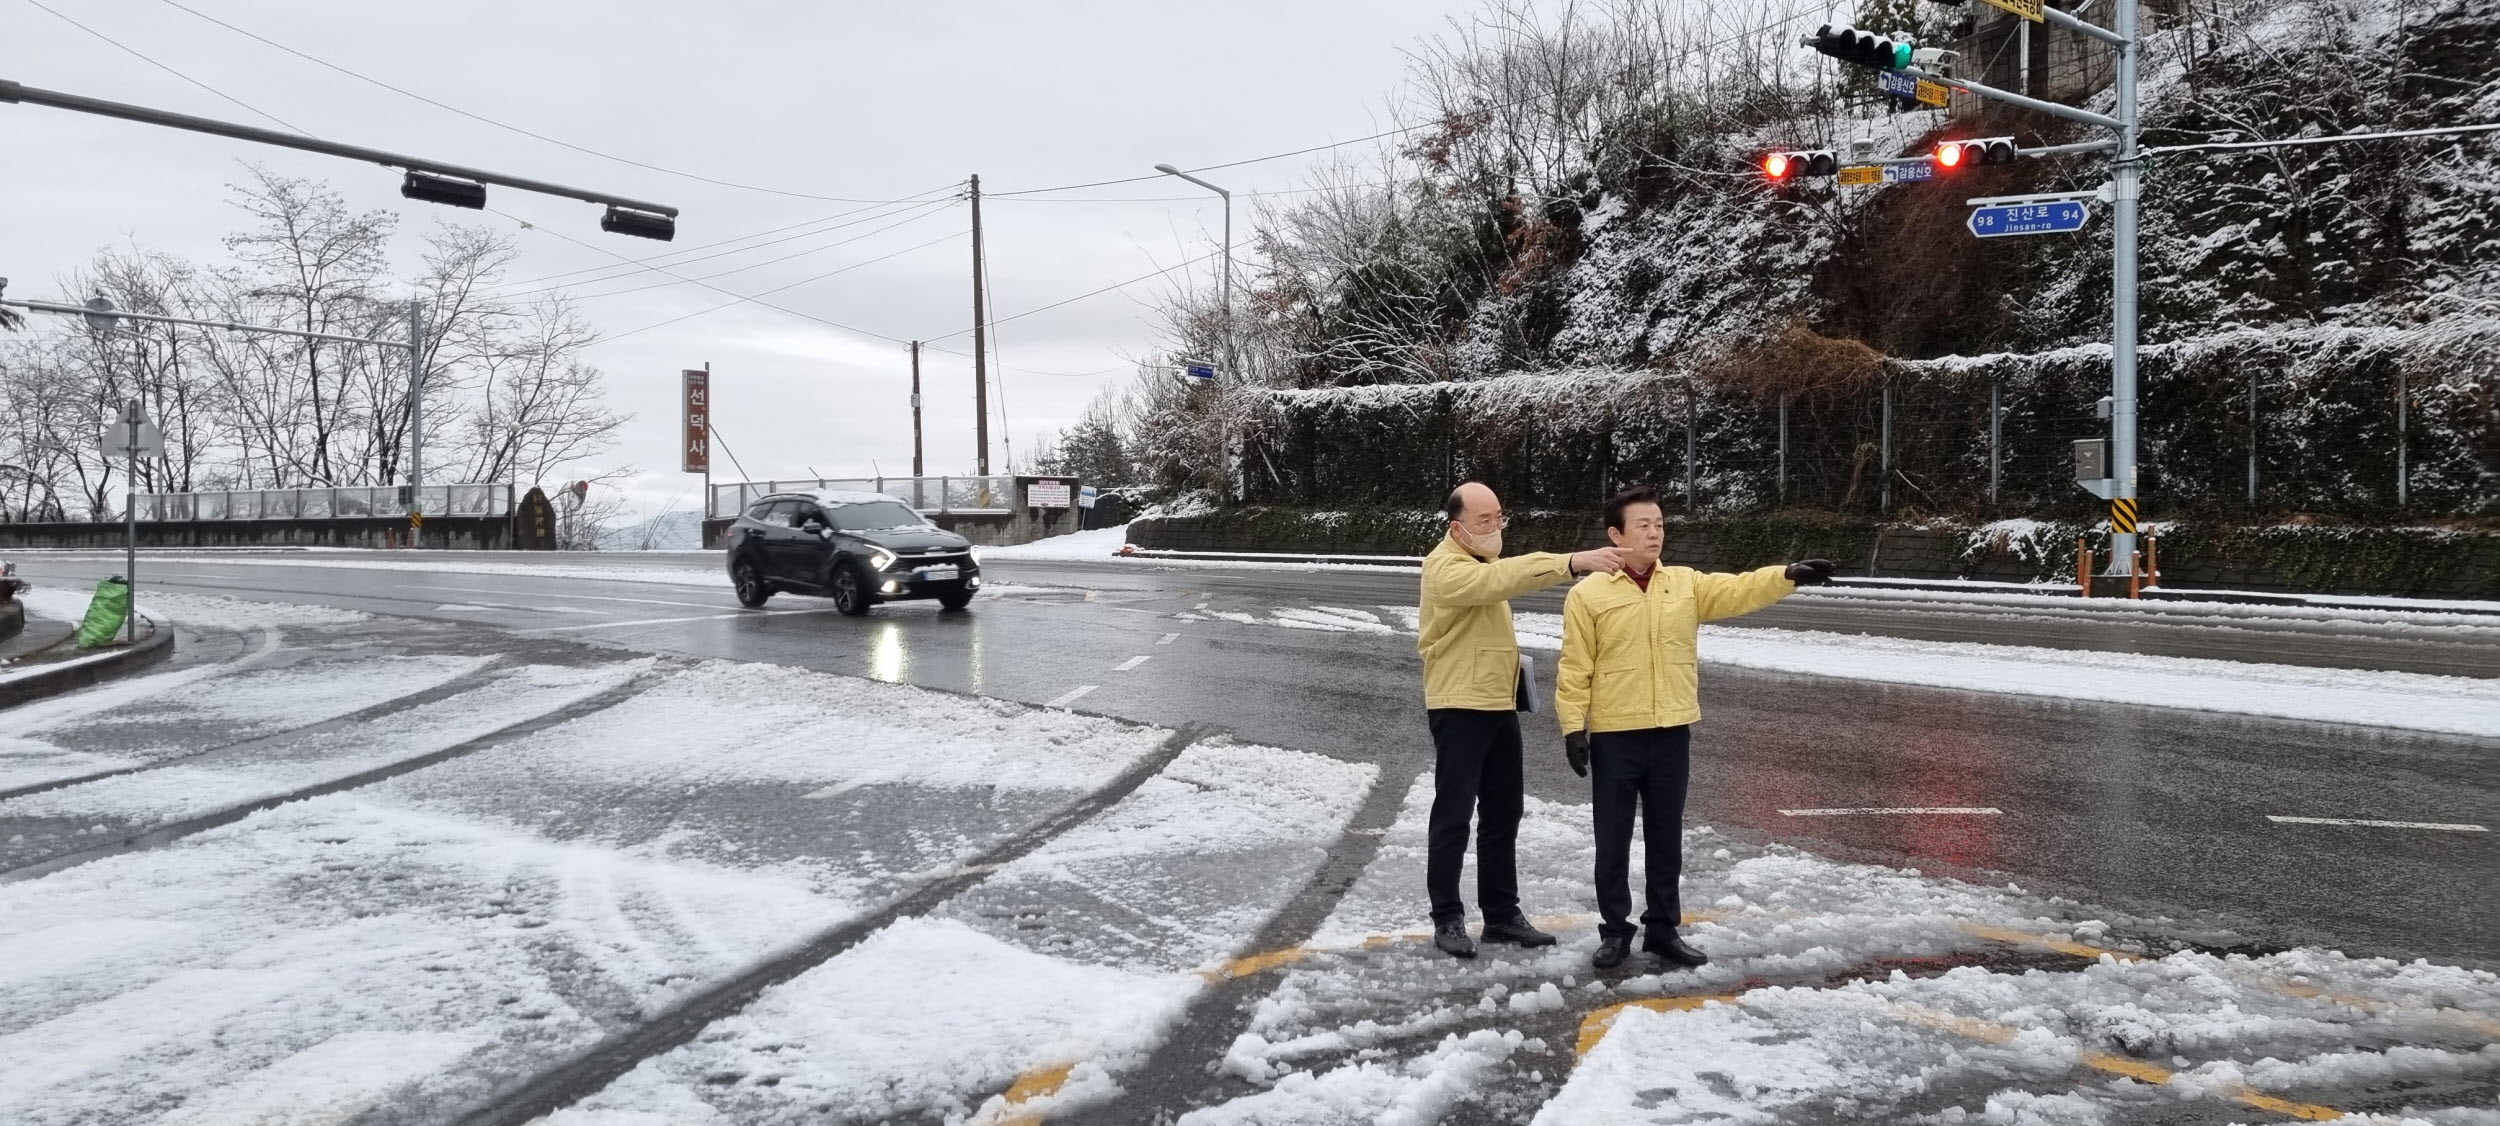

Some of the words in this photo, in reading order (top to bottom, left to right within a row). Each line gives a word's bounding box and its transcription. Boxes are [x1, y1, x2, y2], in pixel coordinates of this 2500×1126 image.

[1891, 75, 1915, 94] 감응신호
[1899, 166, 1932, 179] 감응신호
[2006, 206, 2049, 221] 진산로
[2062, 209, 2079, 220] 94
[1977, 216, 1994, 226] 98
[2004, 222, 2052, 232] Jinsan-ro
[689, 389, 705, 456] 선덕사
